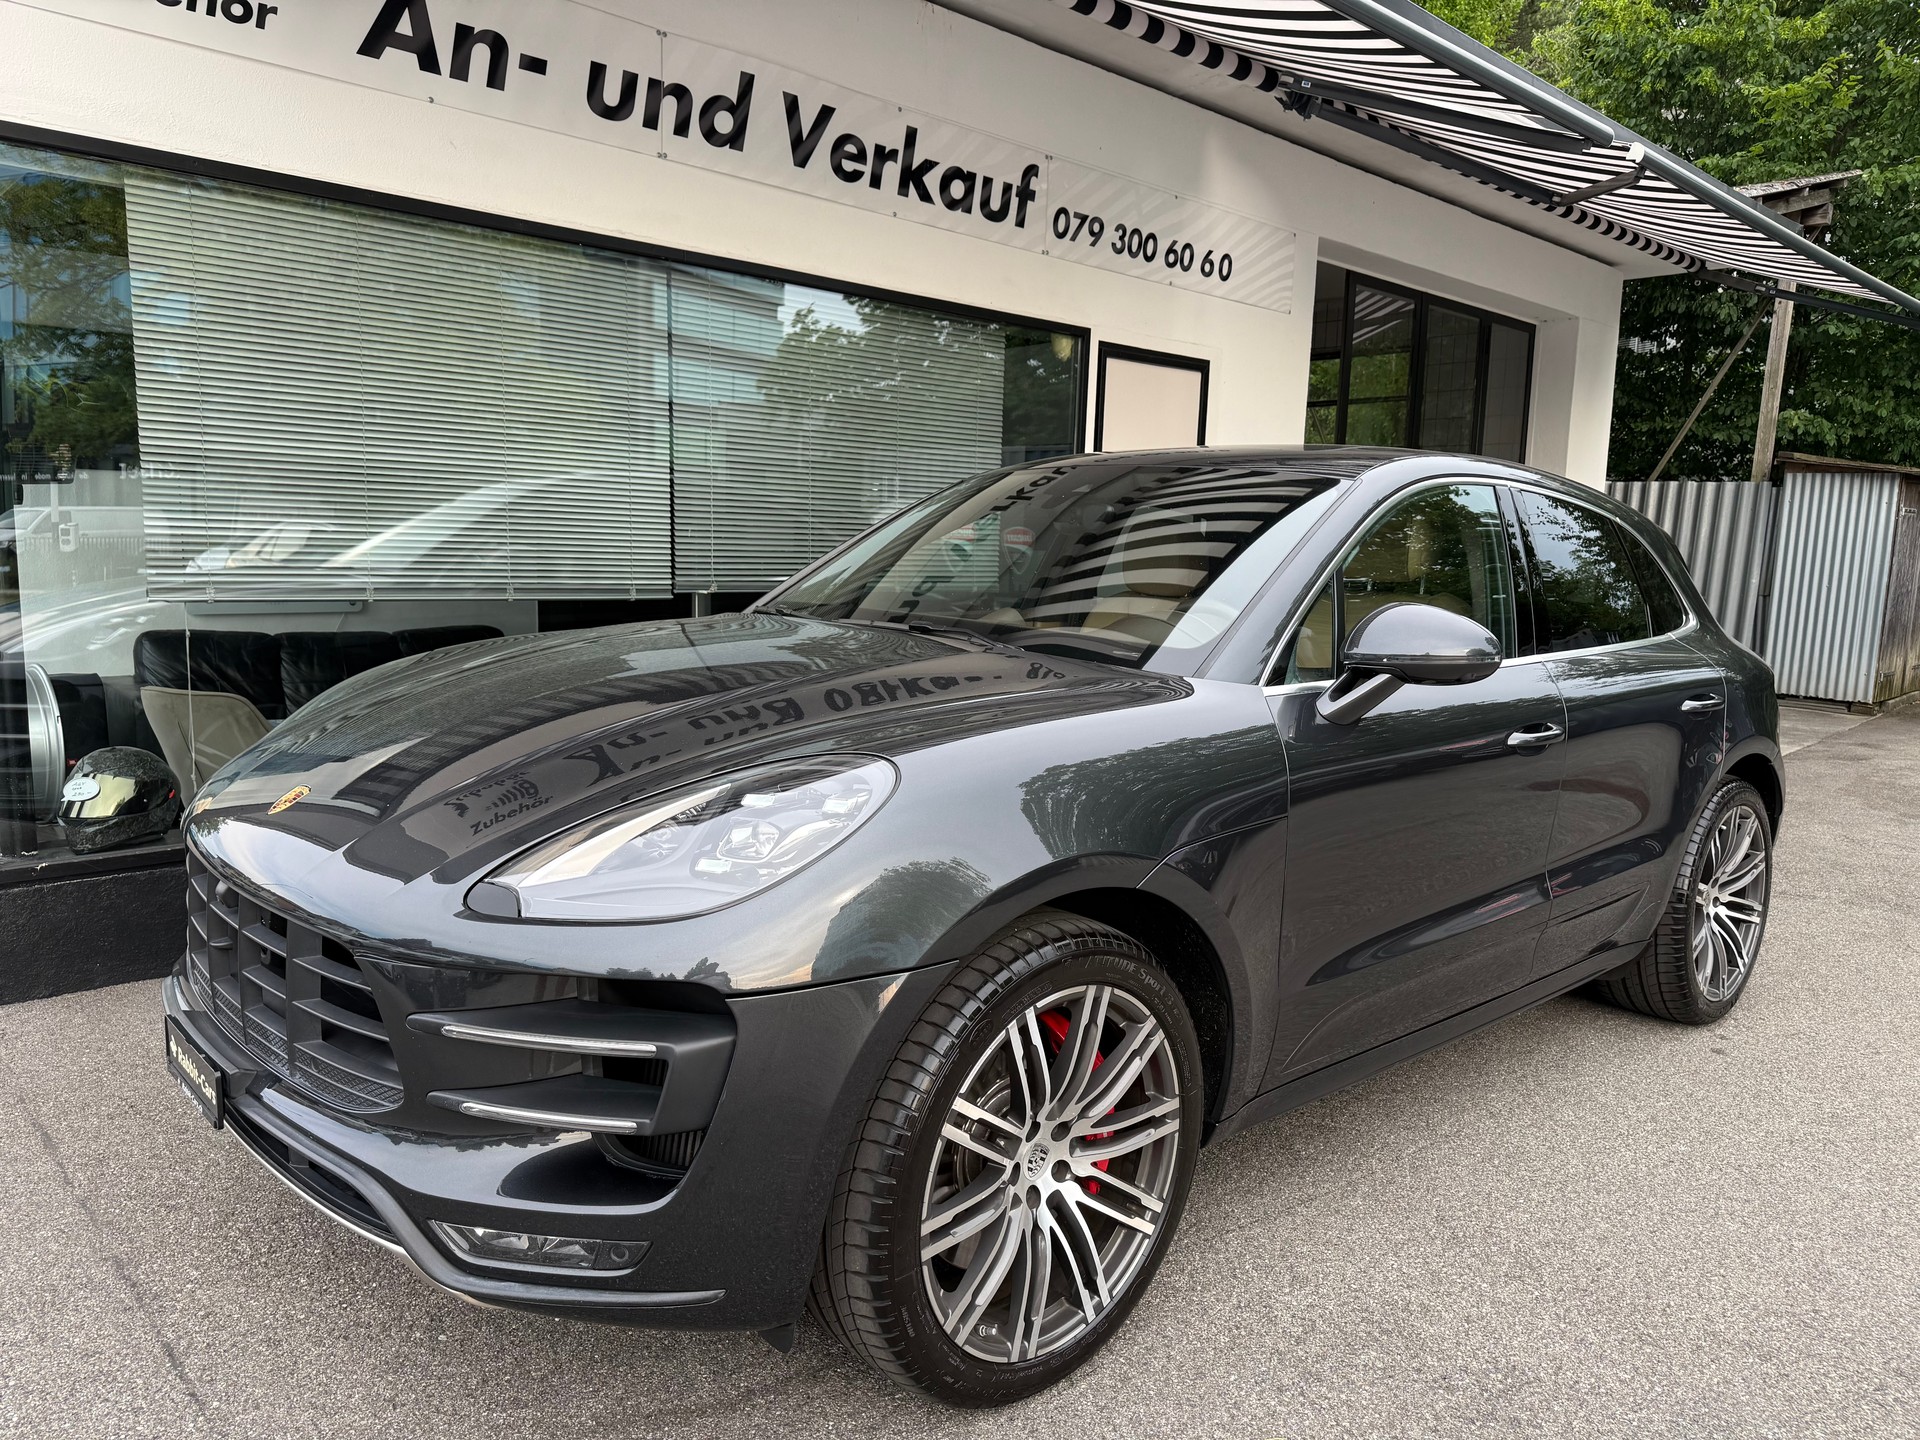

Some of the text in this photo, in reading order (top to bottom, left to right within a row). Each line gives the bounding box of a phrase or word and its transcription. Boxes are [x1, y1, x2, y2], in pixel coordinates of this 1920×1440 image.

[356, 0, 1040, 229] An- und Verkauf
[1052, 206, 1105, 248] 079
[1111, 223, 1158, 263] 300
[1164, 239, 1195, 272] 60
[1138, 968, 1167, 996] Sport
[178, 1046, 217, 1106] Rabbit-Cars
